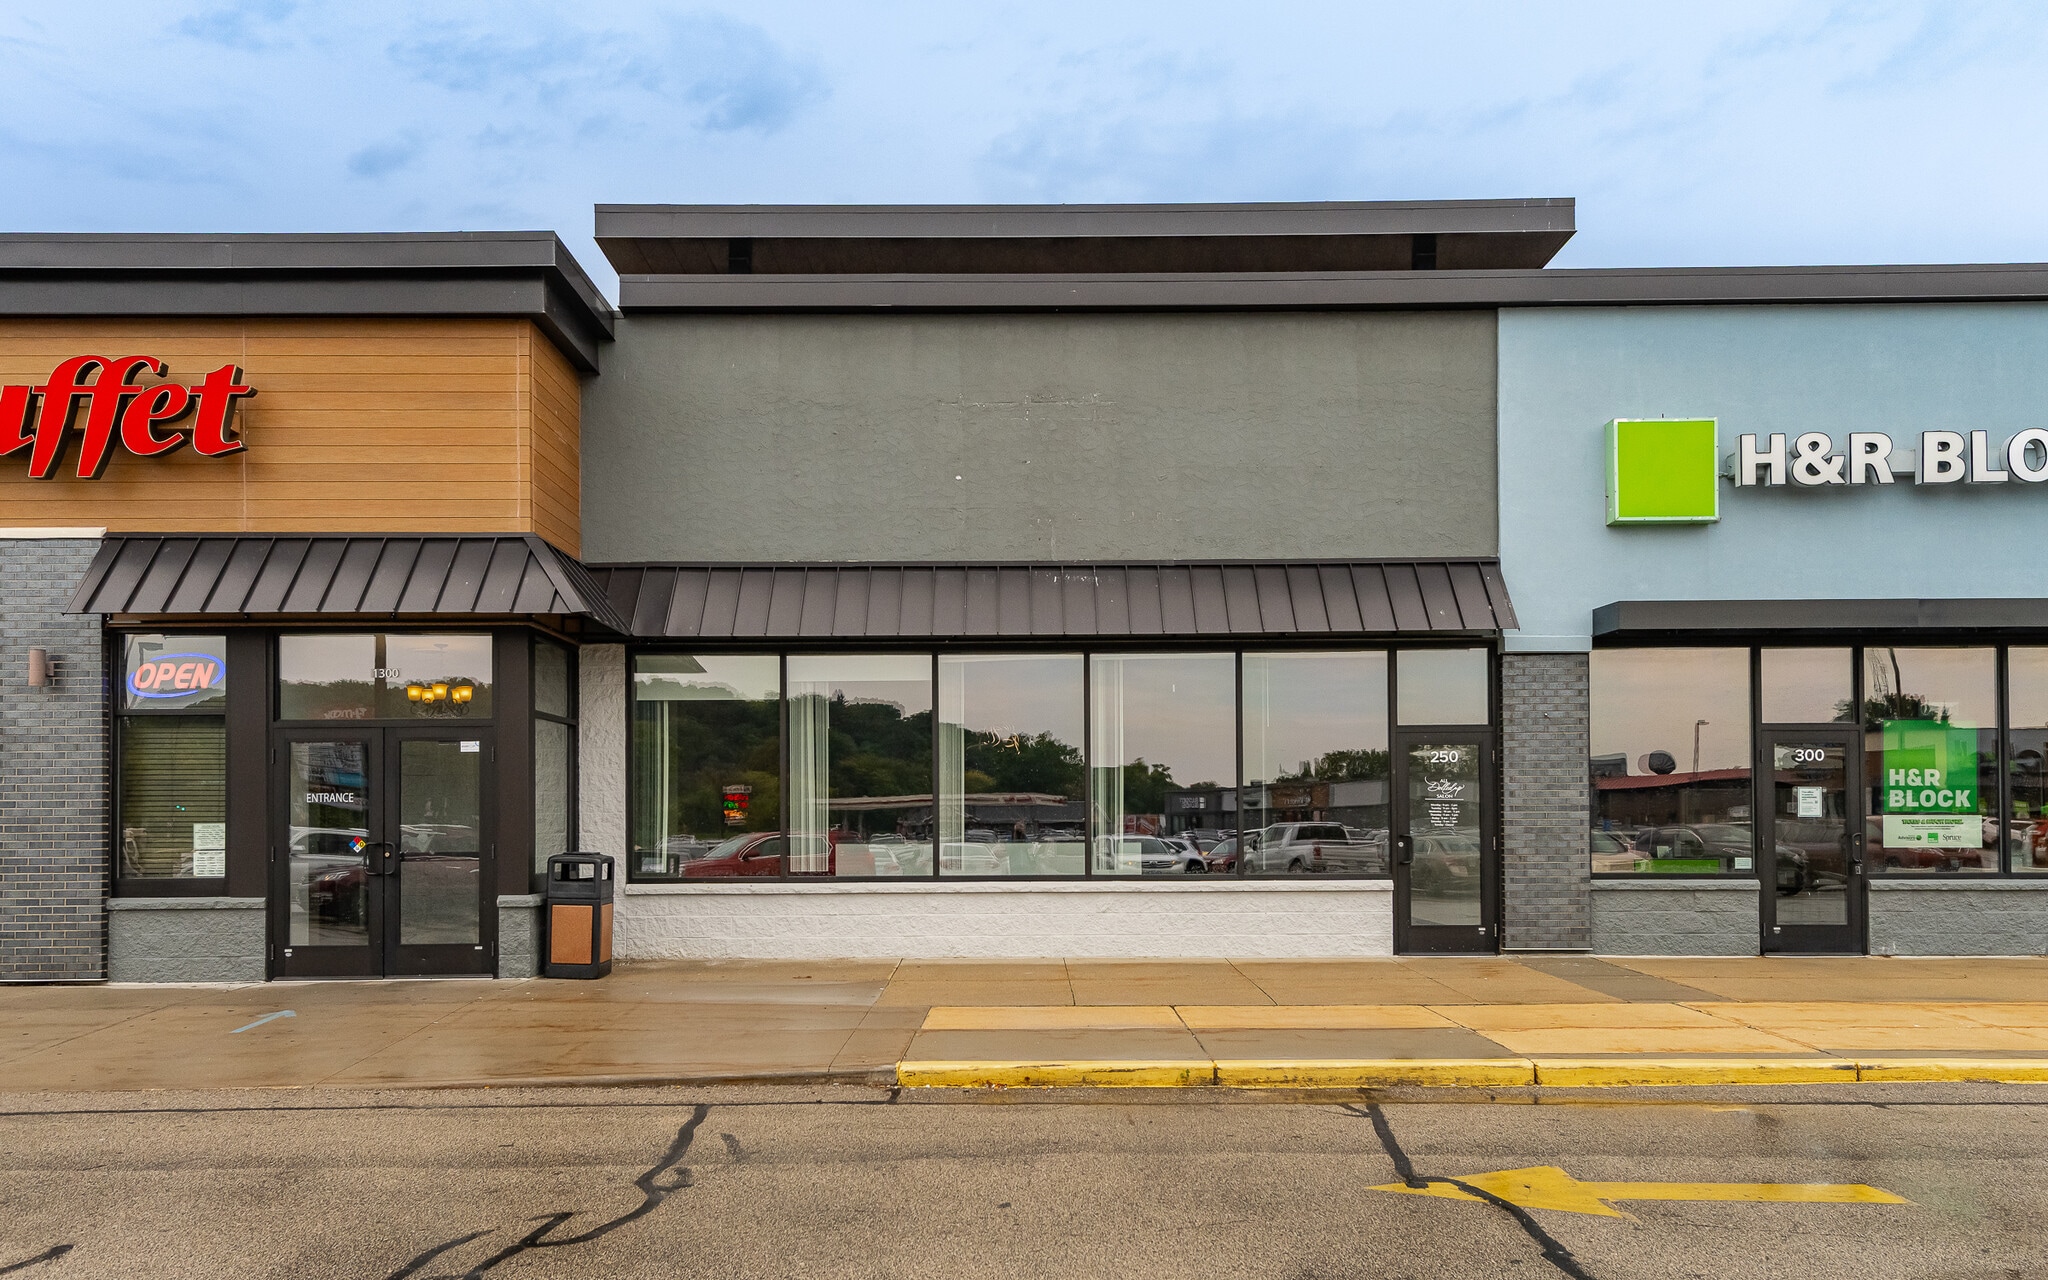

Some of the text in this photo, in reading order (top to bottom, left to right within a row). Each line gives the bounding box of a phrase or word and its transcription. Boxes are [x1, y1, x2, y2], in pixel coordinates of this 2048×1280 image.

[1735, 431, 1895, 487] H&R
[134, 662, 215, 690] OPEN
[373, 668, 399, 678] 1300
[1430, 750, 1459, 763] 250
[1795, 748, 1825, 761] 300
[1889, 768, 1941, 787] H&R
[306, 792, 354, 803] ENTRANCE
[1889, 789, 1971, 808] BLOCK
